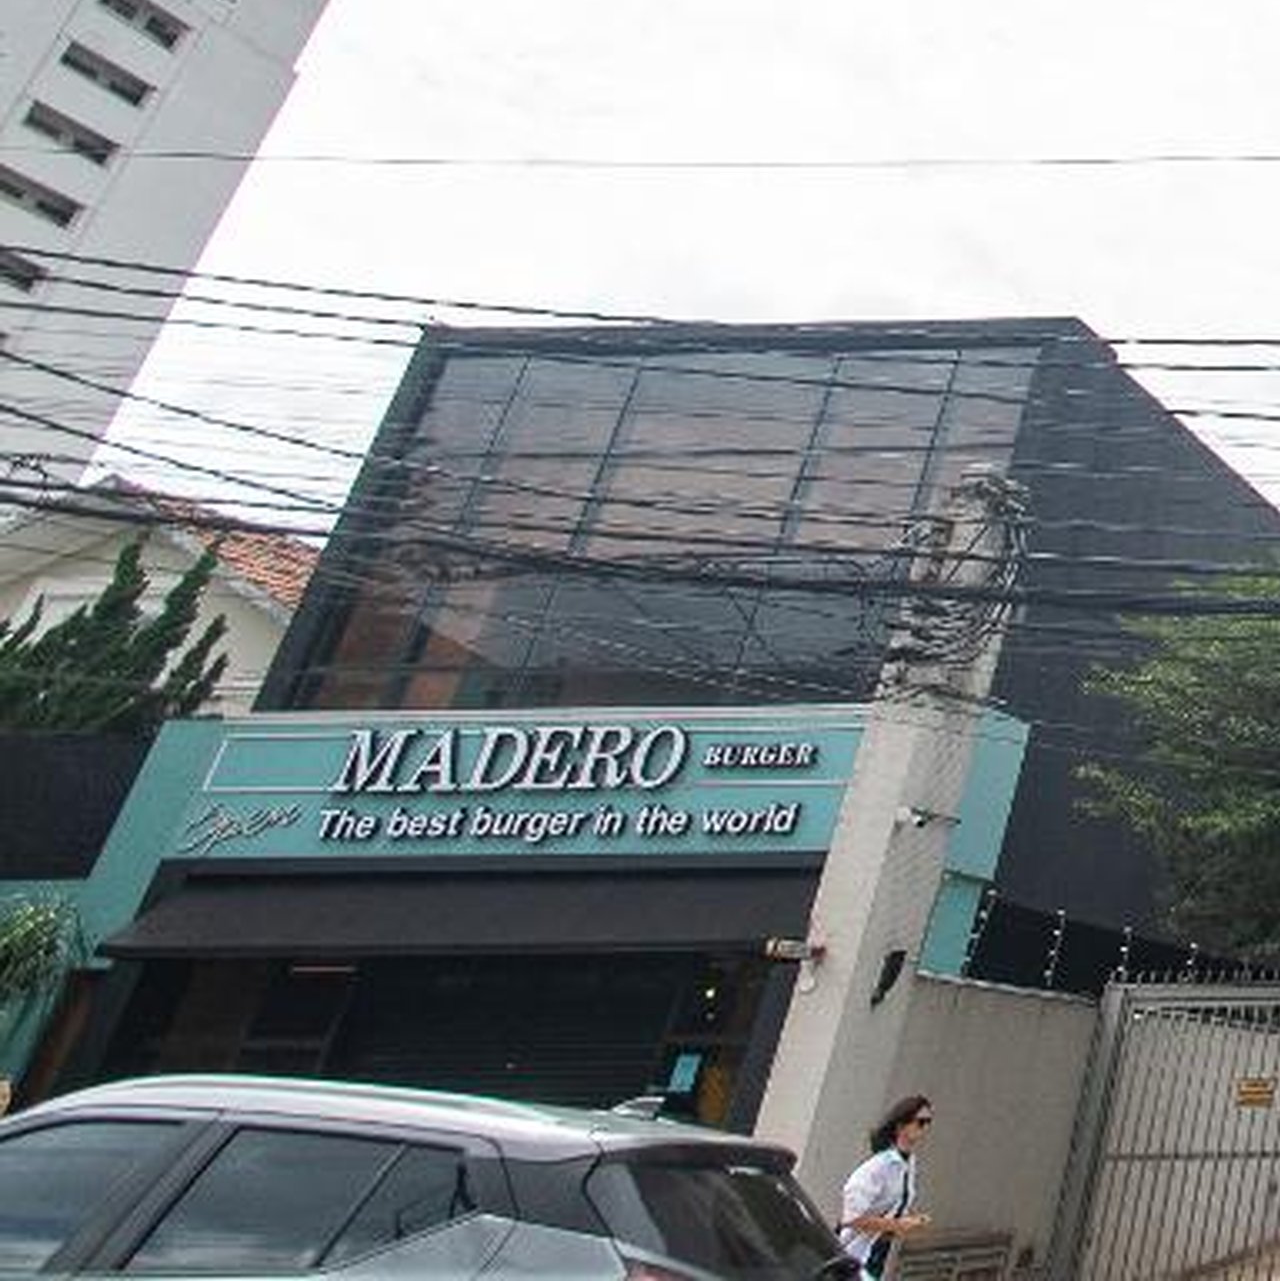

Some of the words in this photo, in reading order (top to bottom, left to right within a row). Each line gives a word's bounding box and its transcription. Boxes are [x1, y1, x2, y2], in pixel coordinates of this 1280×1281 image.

[327, 725, 687, 793] MADERO
[702, 742, 815, 767] BURGER
[318, 808, 374, 839] The
[386, 806, 459, 836] best
[469, 805, 586, 842] burger
[592, 804, 622, 834] in
[635, 804, 688, 834] the
[702, 802, 800, 833] world
